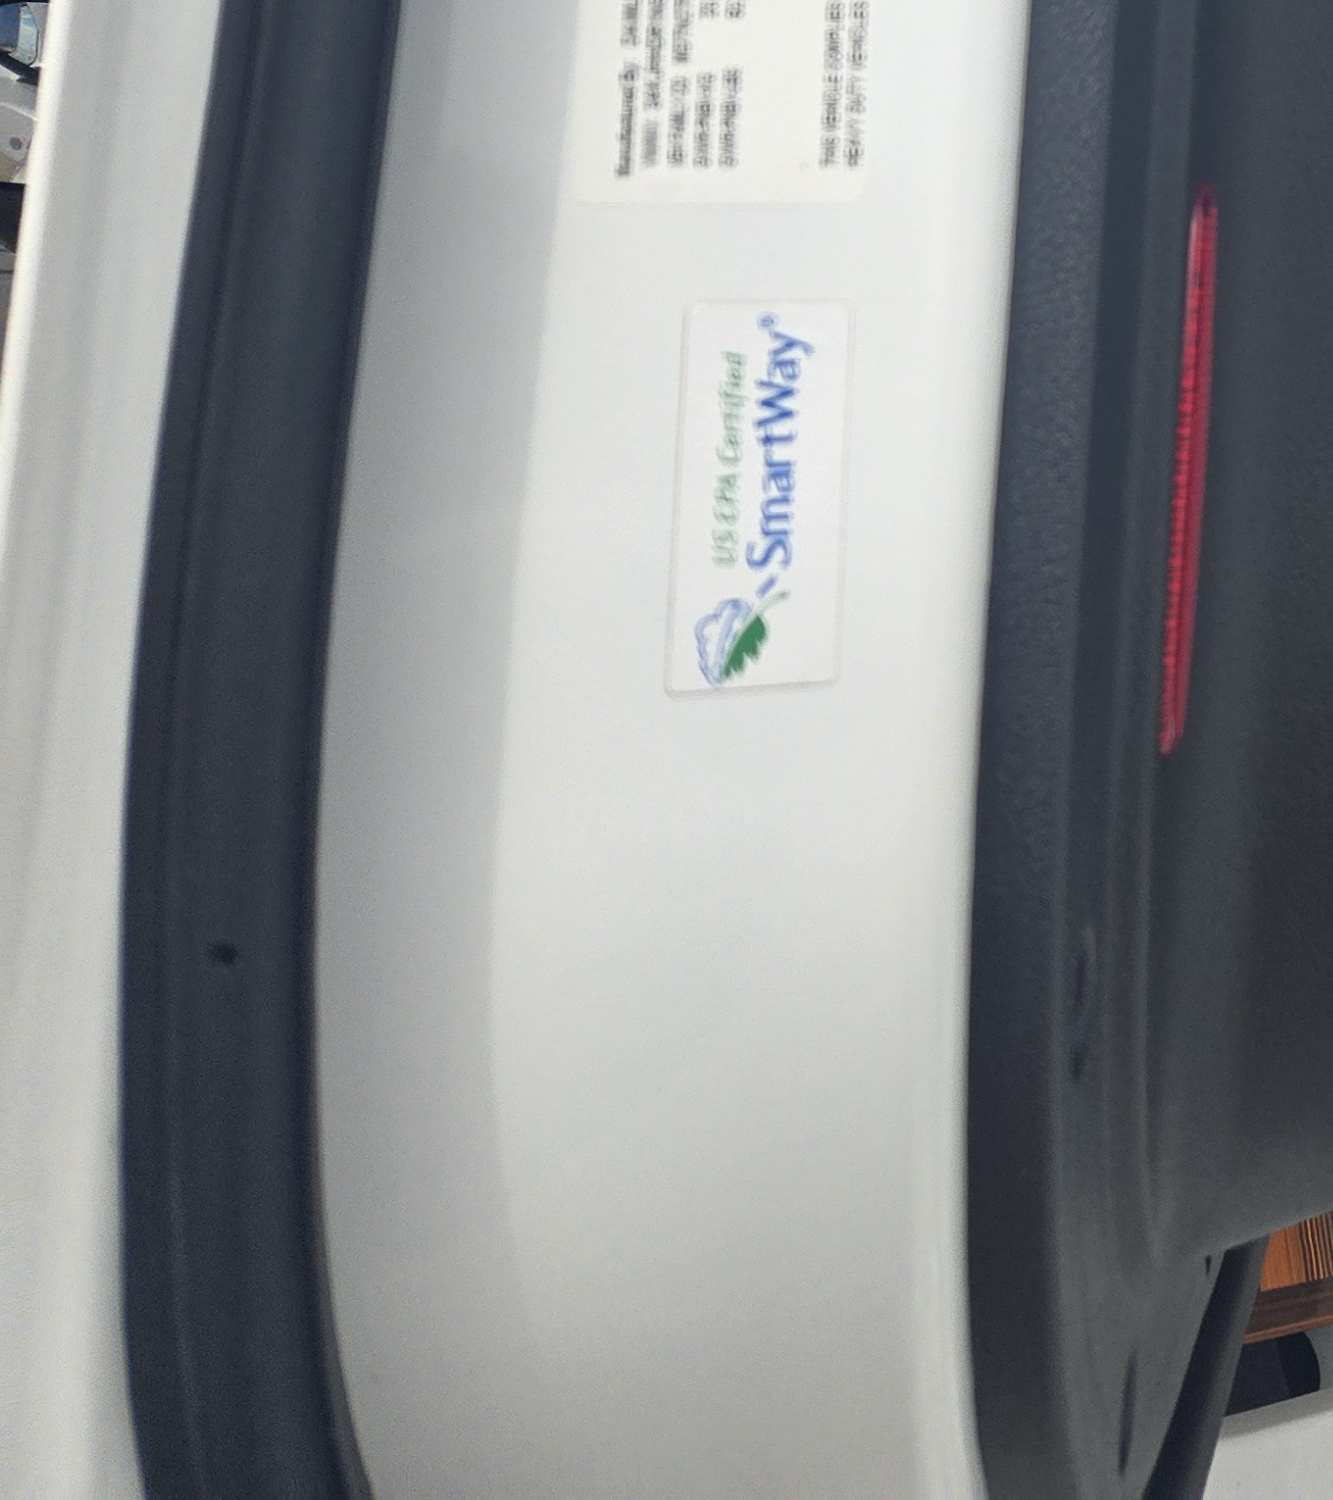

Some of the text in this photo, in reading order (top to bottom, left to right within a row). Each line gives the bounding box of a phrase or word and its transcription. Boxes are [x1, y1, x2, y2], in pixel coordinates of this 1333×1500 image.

[825, 1, 843, 71] COMPLIES
[848, 0, 868, 71] VEHICLES
[822, 74, 841, 133] VEHICLE
[846, 74, 865, 115] DUTY
[820, 134, 838, 168] THIS
[845, 118, 861, 168] HEAVY
[711, 348, 749, 569] US EPA Certified
